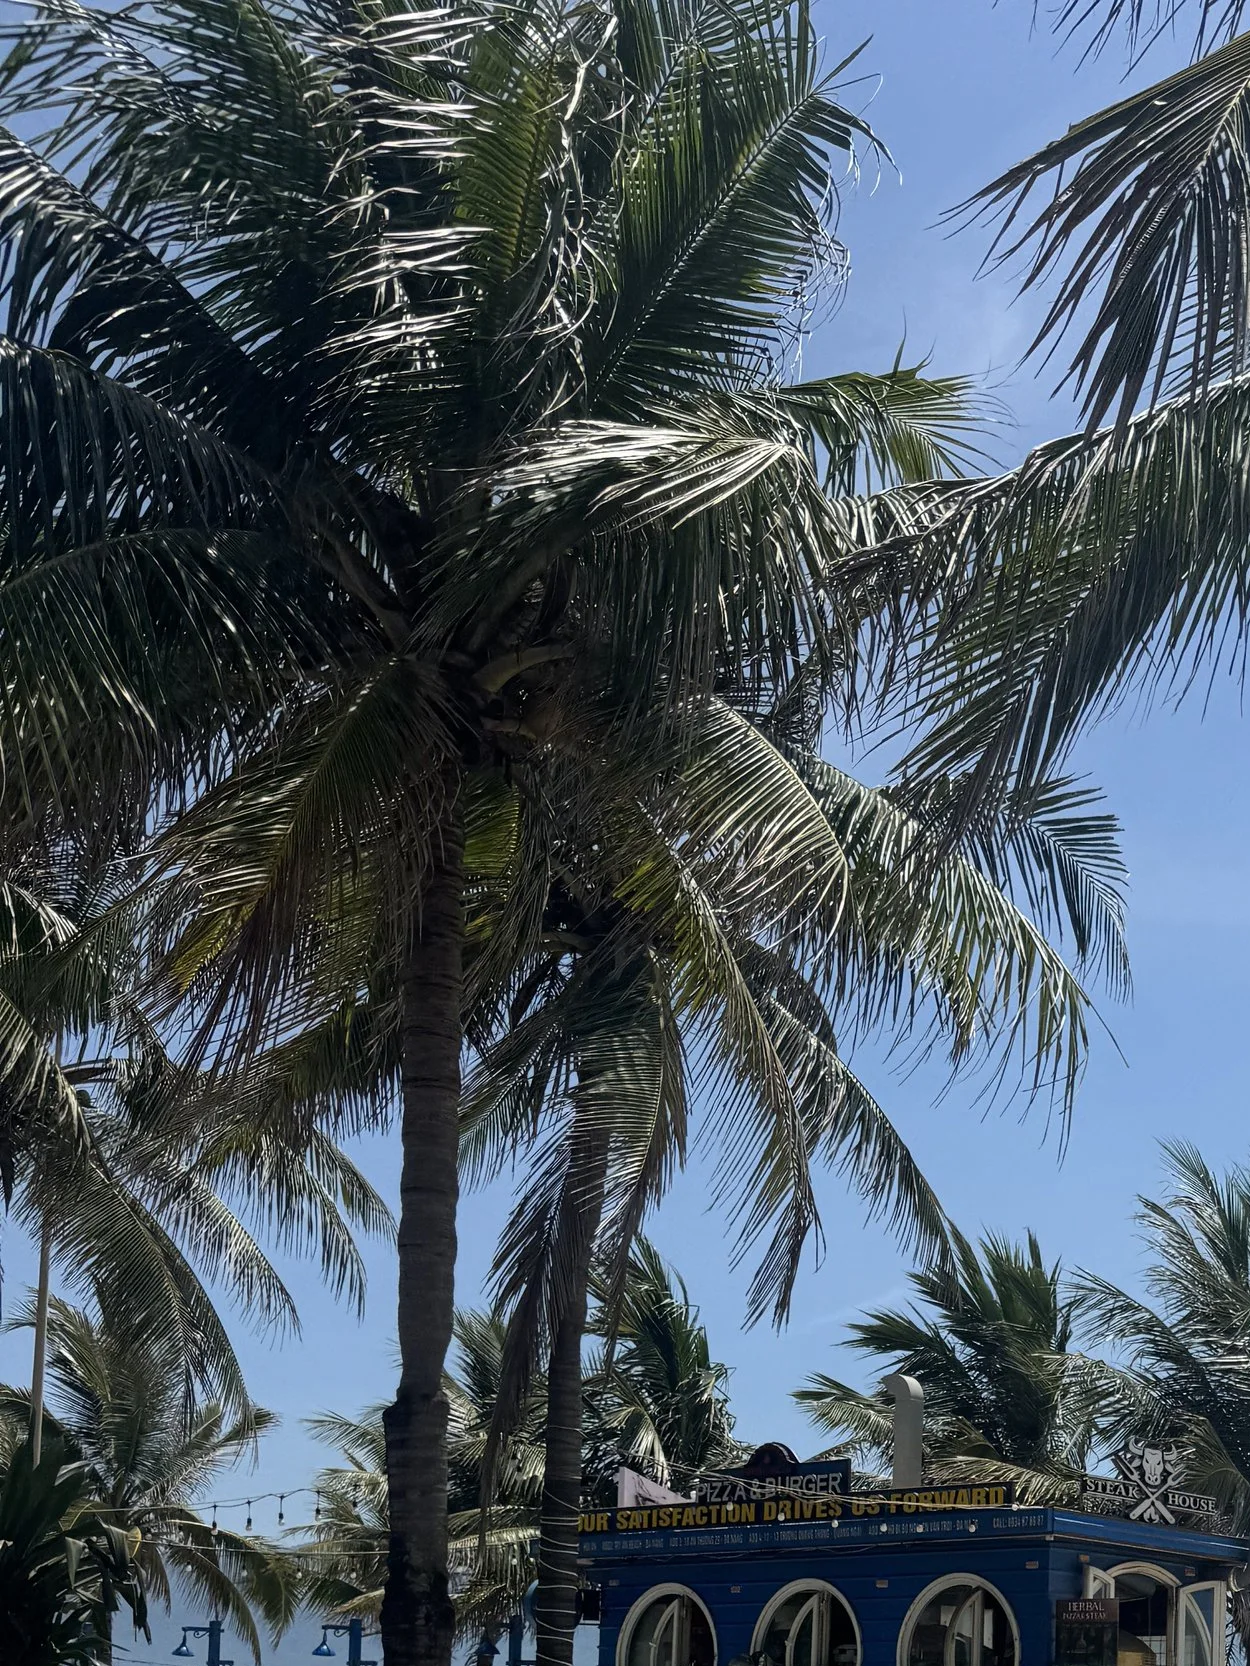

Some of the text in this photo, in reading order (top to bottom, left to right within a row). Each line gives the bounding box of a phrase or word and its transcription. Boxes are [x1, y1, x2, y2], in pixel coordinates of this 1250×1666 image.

[695, 1481, 746, 1503] PIZZA
[765, 1472, 841, 1498] BURGER
[1086, 1479, 1217, 1512] STEAK HOUSE
[616, 1502, 755, 1530] SATISFACTION
[763, 1498, 842, 1521] DRIVES
[852, 1495, 880, 1516] US
[890, 1487, 1004, 1513] FORWARD
